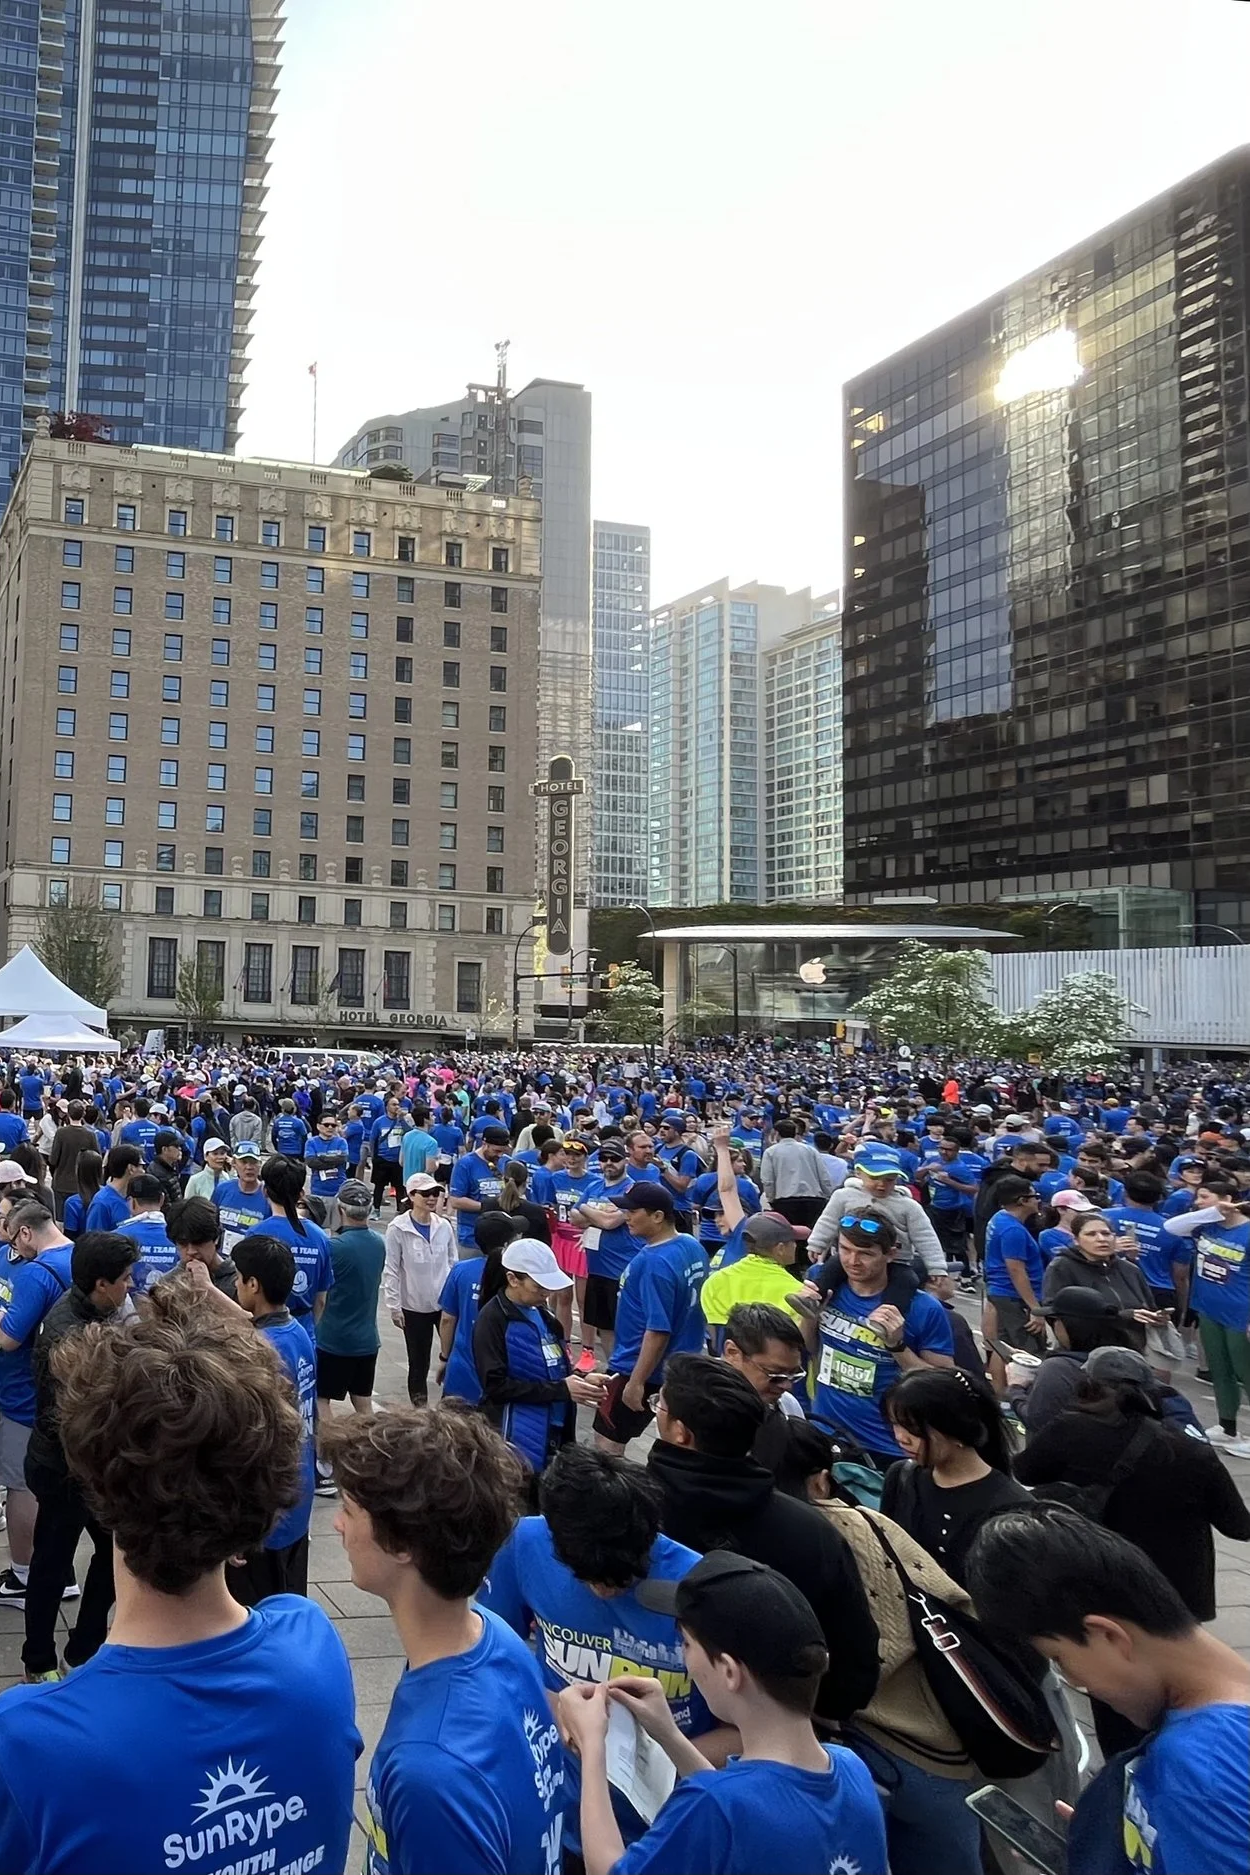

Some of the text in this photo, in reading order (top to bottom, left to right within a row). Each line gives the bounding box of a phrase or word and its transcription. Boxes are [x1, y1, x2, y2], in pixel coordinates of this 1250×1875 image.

[540, 782, 580, 793] HOTEL
[551, 800, 569, 935] GEORGIA
[340, 1010, 448, 1027] HOTEL GEORGIA
[153, 1246, 176, 1254] TEAM
[834, 1359, 872, 1381] 16857
[163, 1795, 306, 1869] SunRype
